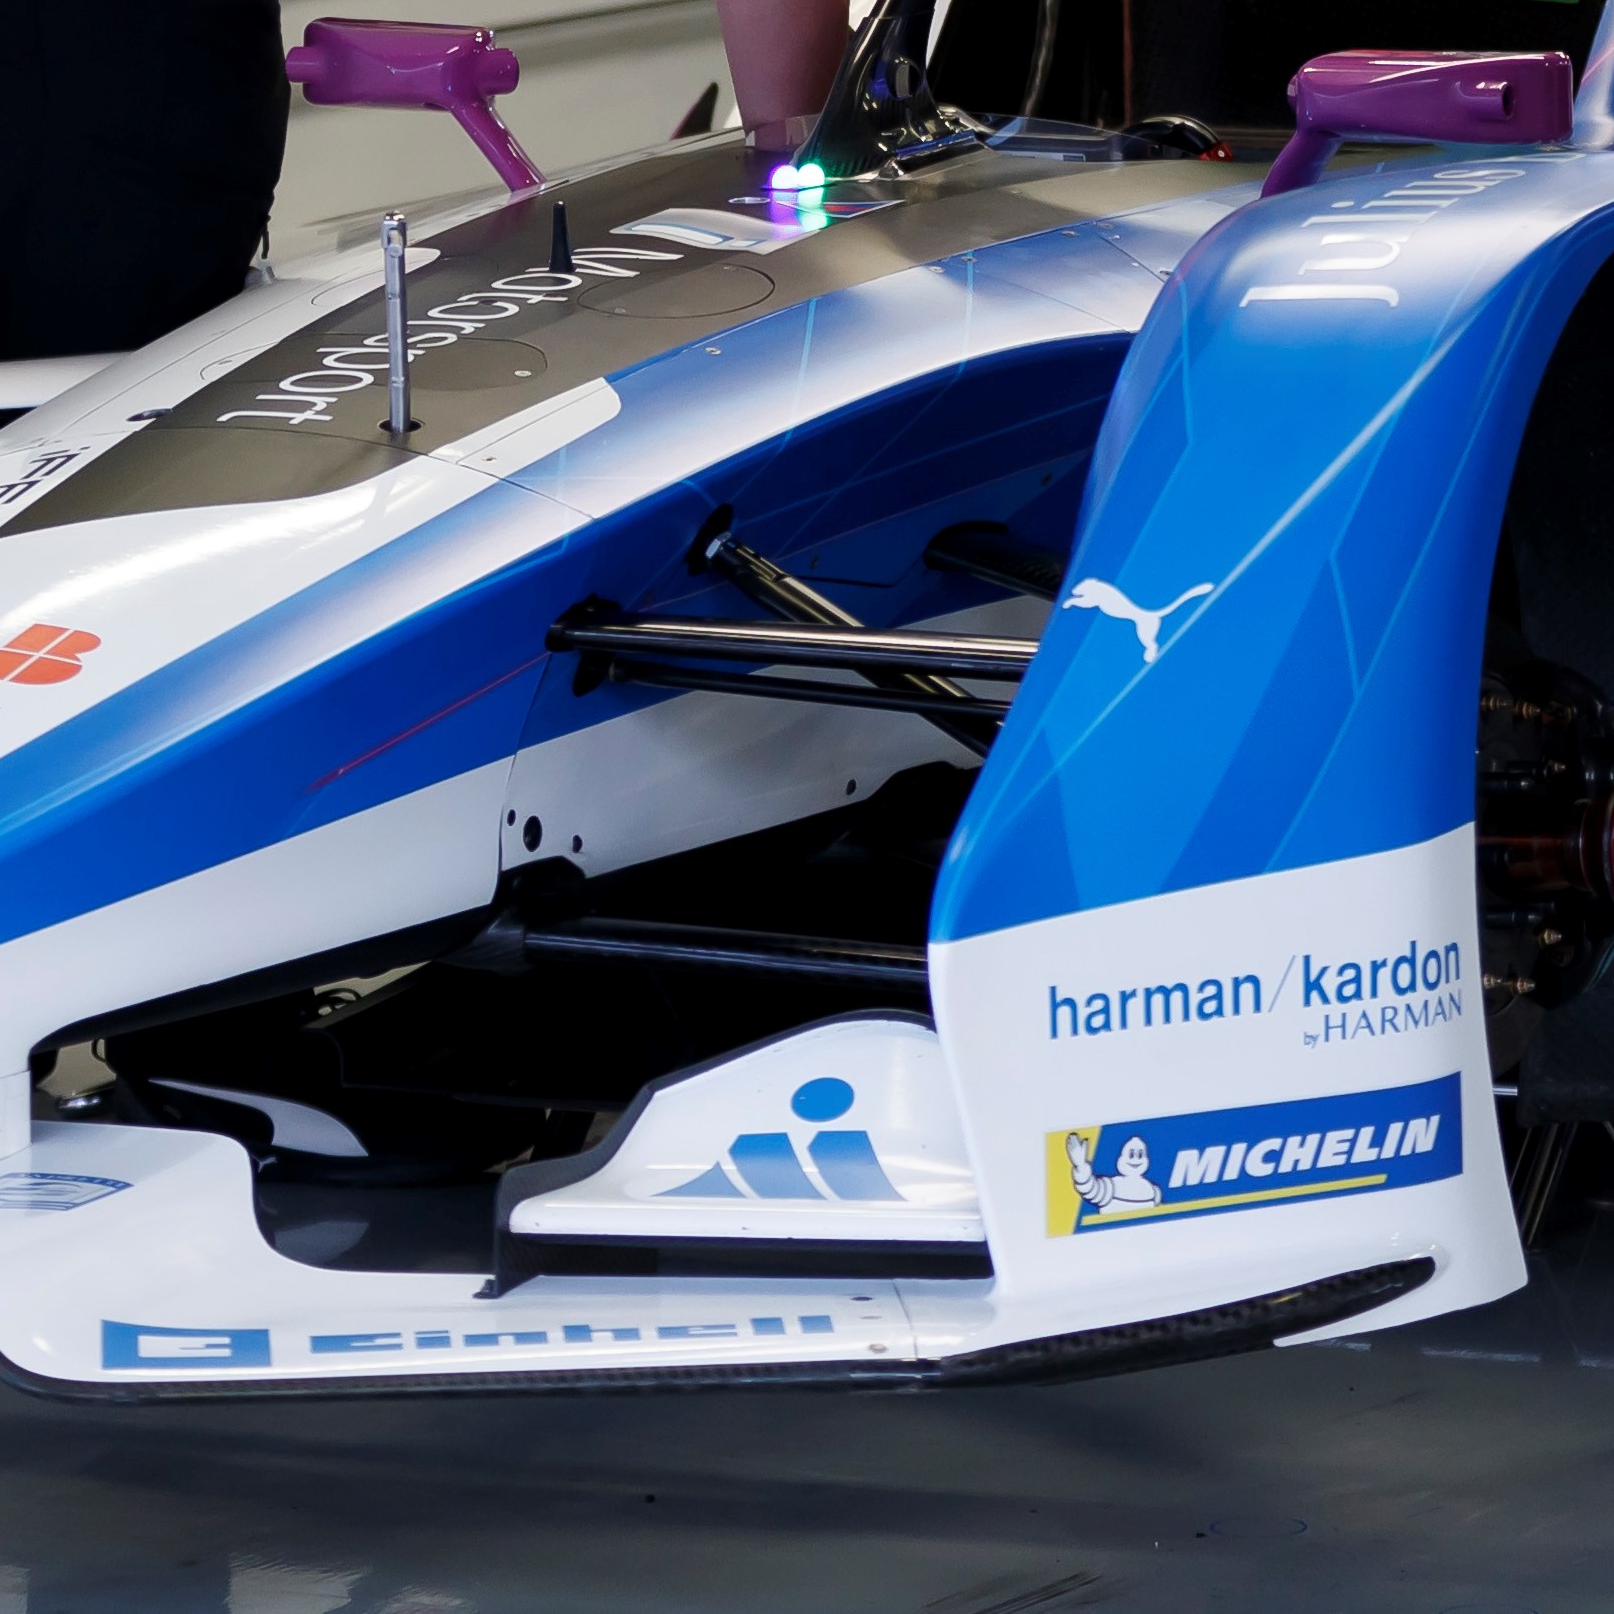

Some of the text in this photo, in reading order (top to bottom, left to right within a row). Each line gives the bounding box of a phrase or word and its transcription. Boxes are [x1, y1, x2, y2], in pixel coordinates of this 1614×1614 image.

[1239, 168, 1526, 308] Julius
[216, 247, 685, 425] Motorsport
[1049, 939, 1462, 1040] harman/kardon
[1323, 989, 1463, 1045] HARMAN
[1168, 1113, 1441, 1188] MICHELIN
[310, 1315, 834, 1354] Einhell
